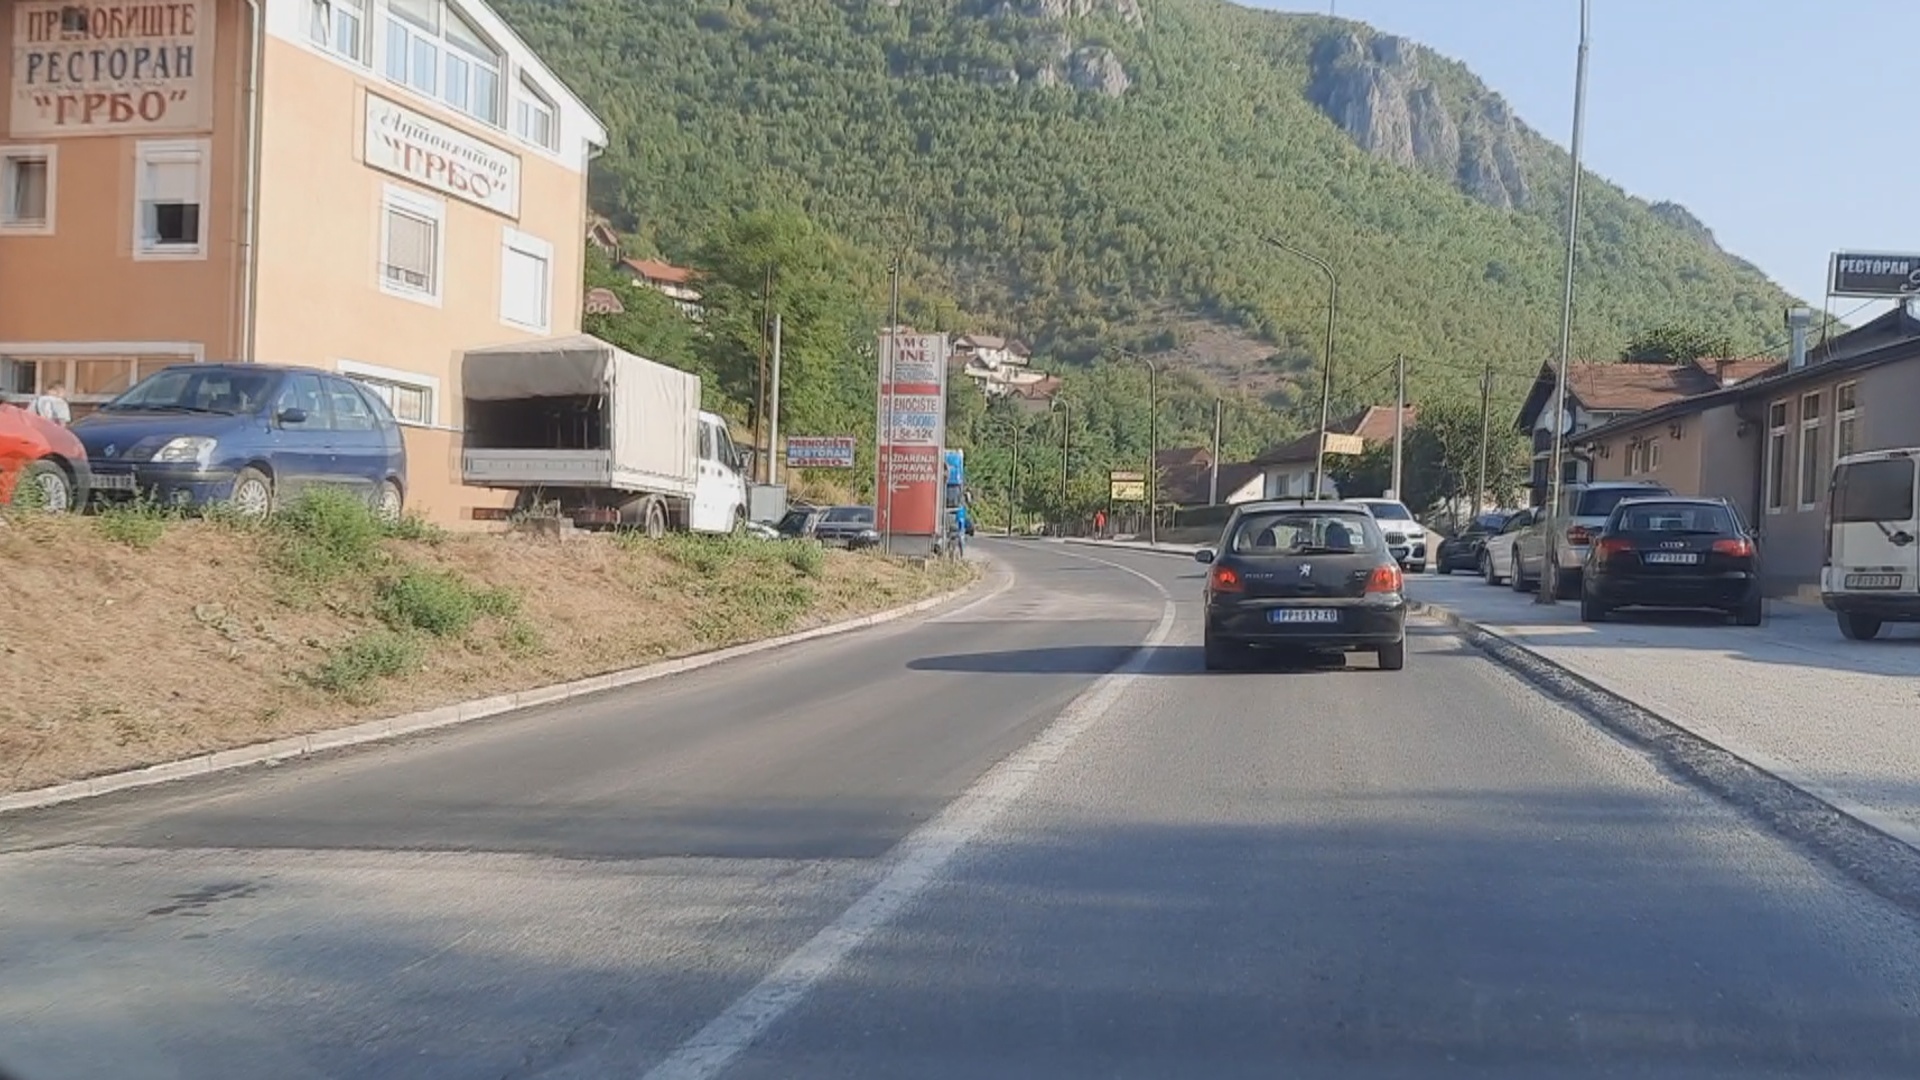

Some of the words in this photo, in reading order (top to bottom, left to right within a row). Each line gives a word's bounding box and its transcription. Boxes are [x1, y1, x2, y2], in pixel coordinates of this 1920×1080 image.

[27, 4, 195, 42] ПРОЋИШТЕ
[27, 45, 193, 84] РЕСТОРАН
[1839, 259, 1910, 275] РЕСТОРАН
